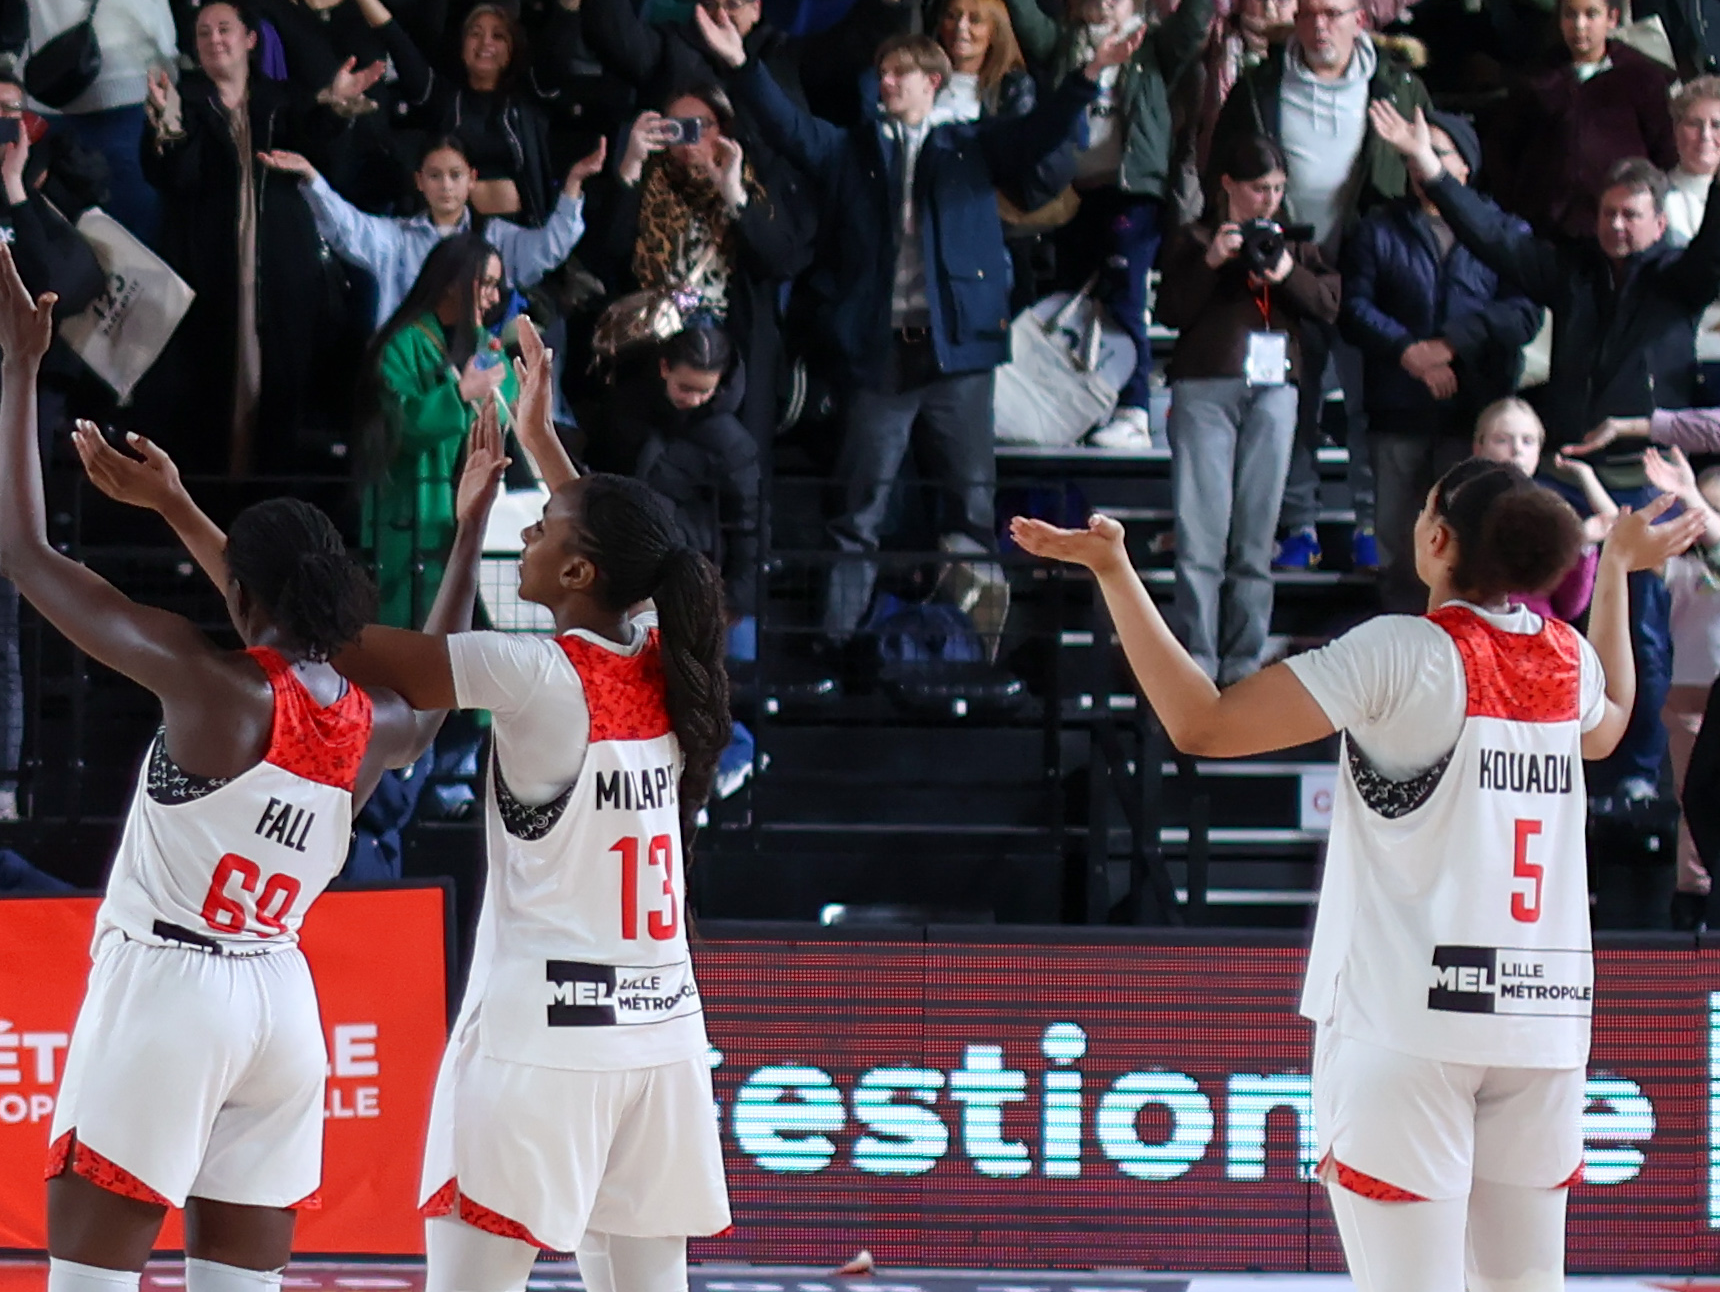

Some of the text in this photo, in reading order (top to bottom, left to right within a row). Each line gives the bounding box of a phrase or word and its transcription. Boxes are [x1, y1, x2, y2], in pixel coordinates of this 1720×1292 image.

[254, 796, 317, 854] FALL
[1510, 818, 1544, 923] 5
[608, 833, 678, 941] 13
[1431, 965, 1496, 993] MEL
[1500, 962, 1544, 978] LILLE
[546, 981, 615, 1007] MEL
[1500, 980, 1592, 1001] MÉTROPOLE
